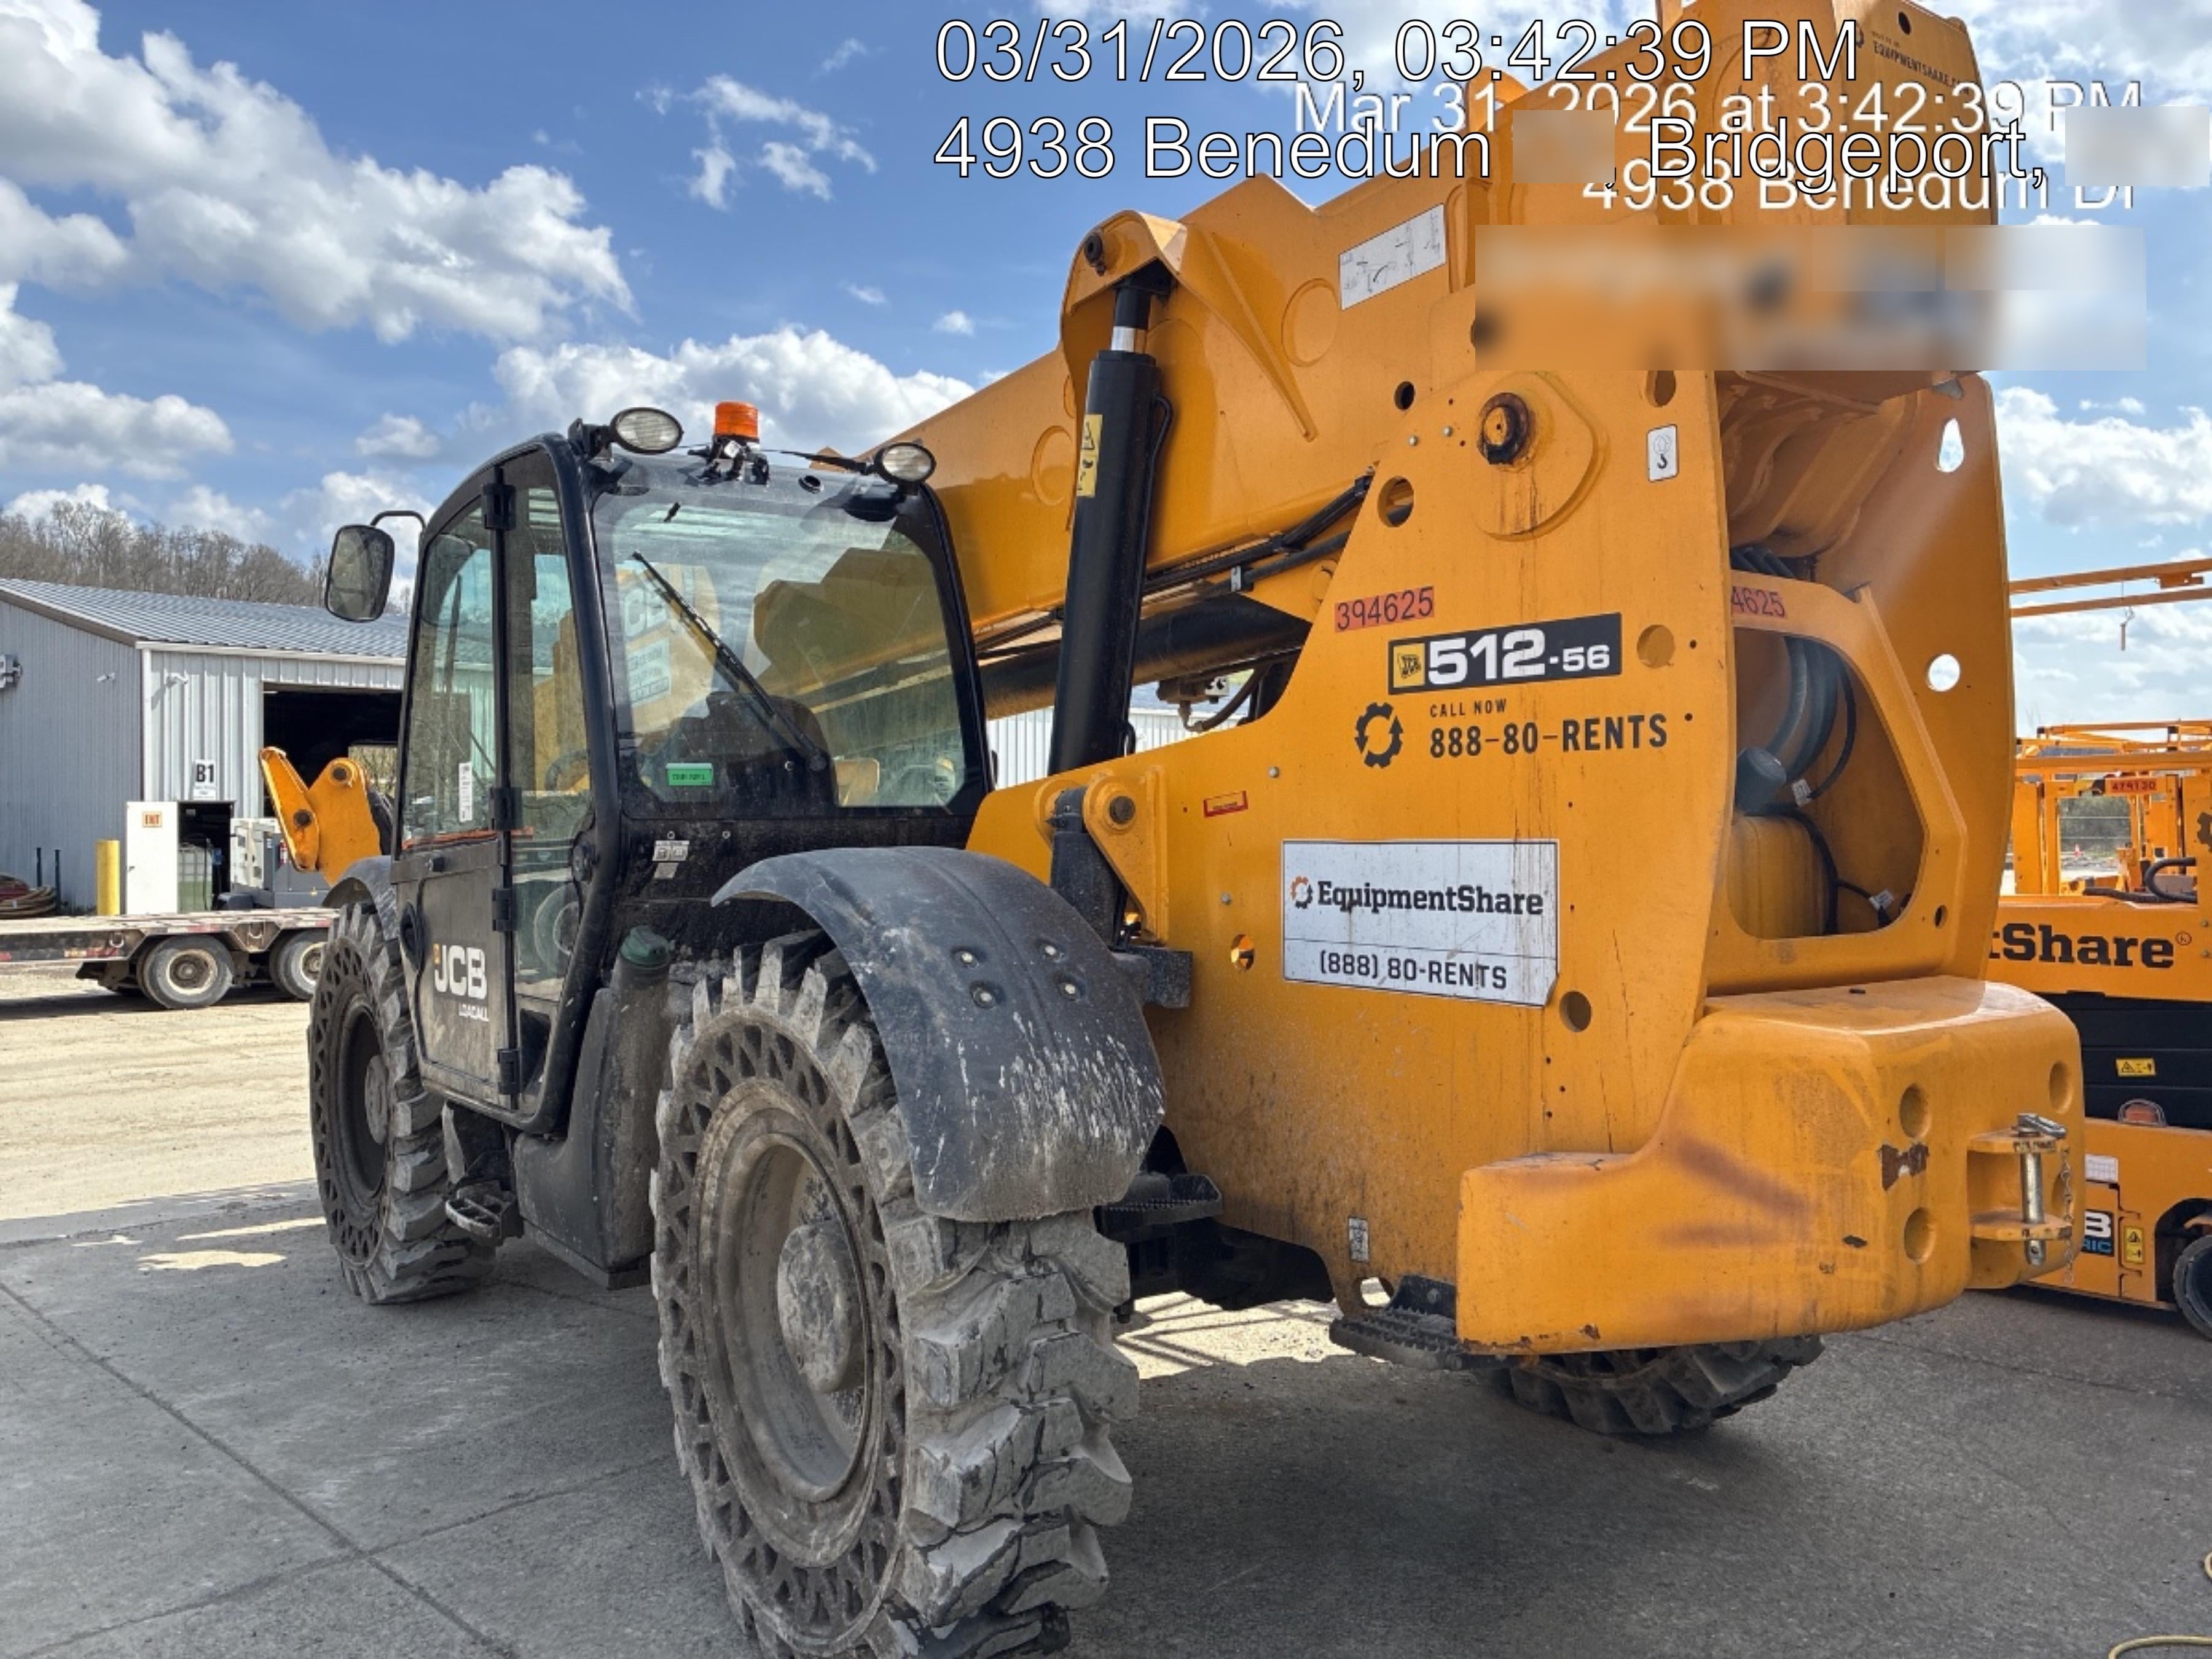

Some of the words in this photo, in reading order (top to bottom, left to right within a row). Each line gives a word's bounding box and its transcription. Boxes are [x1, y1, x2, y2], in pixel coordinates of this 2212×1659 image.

[1873, 40, 1970, 95] EQUIPMENTSHARE.C
[1336, 586, 1434, 630] 394625
[1430, 703, 1465, 718] CALL
[1473, 698, 1507, 715] NOW
[1430, 713, 1668, 758] 888-80-RENTS
[196, 764, 214, 783] B1
[1317, 880, 1544, 915] EquipmentShare
[435, 945, 487, 1000] JCB
[1320, 949, 1378, 979] (888)
[1387, 957, 1507, 990] 80-RENTS
